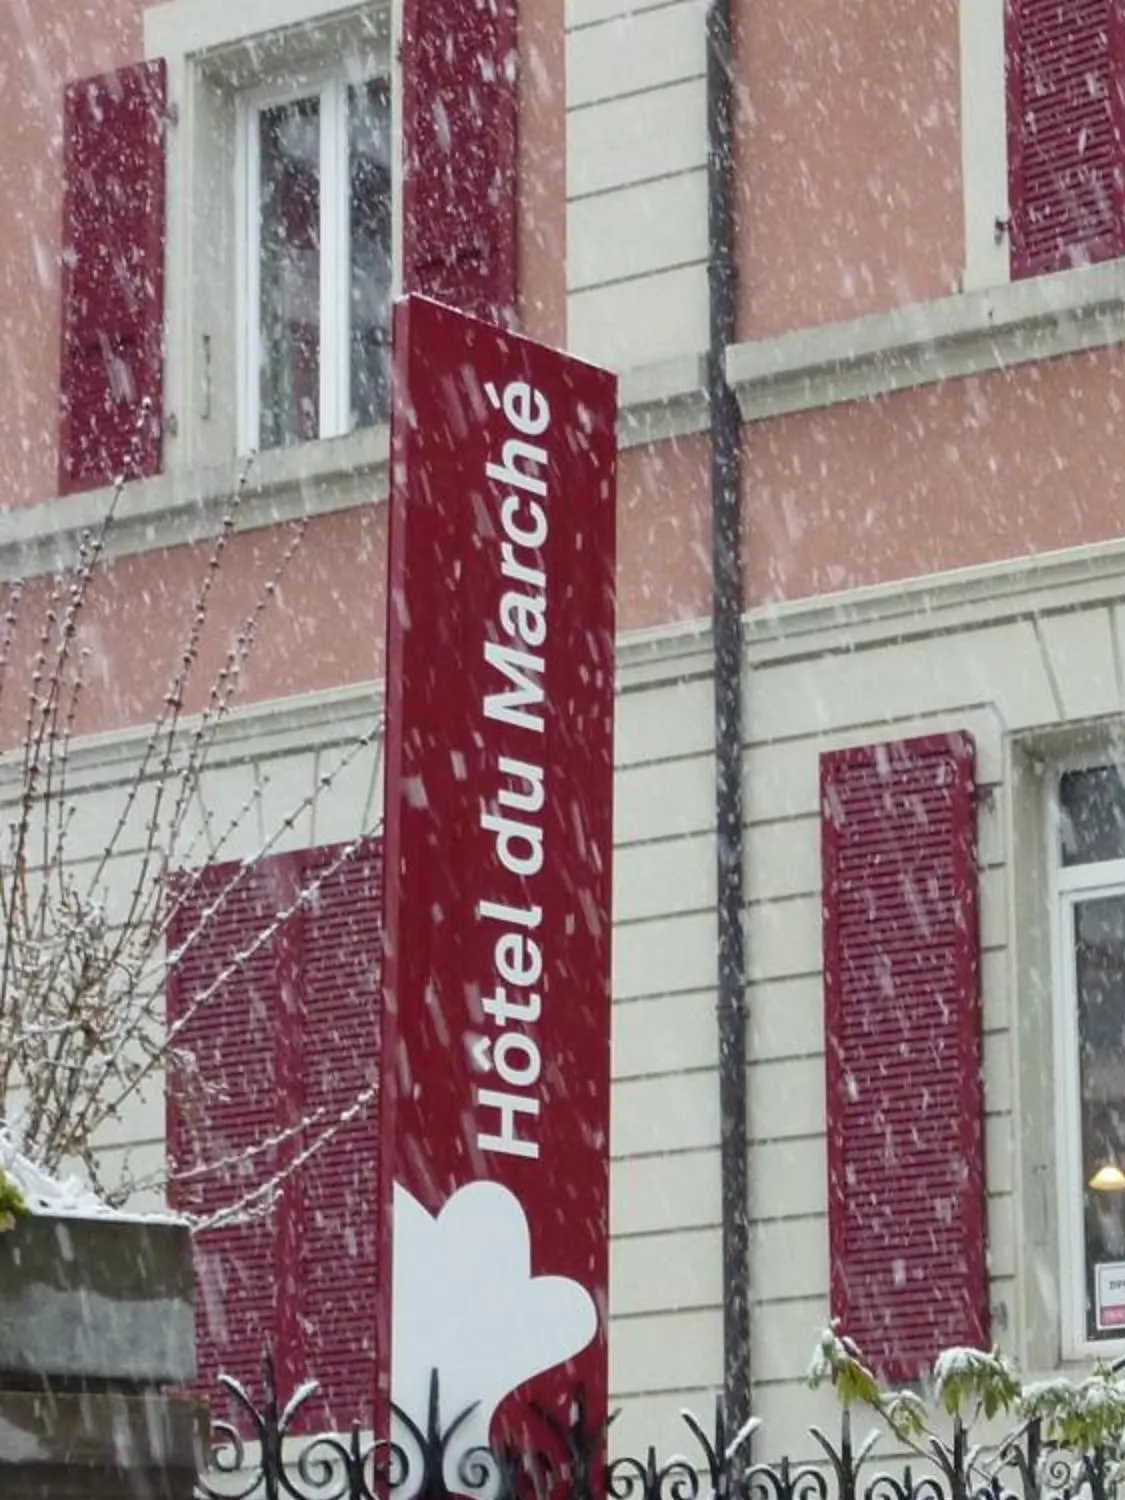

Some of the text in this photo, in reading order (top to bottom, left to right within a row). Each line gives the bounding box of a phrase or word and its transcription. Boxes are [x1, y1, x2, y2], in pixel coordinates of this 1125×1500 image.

[475, 379, 551, 1160] Hôtel du Marché
